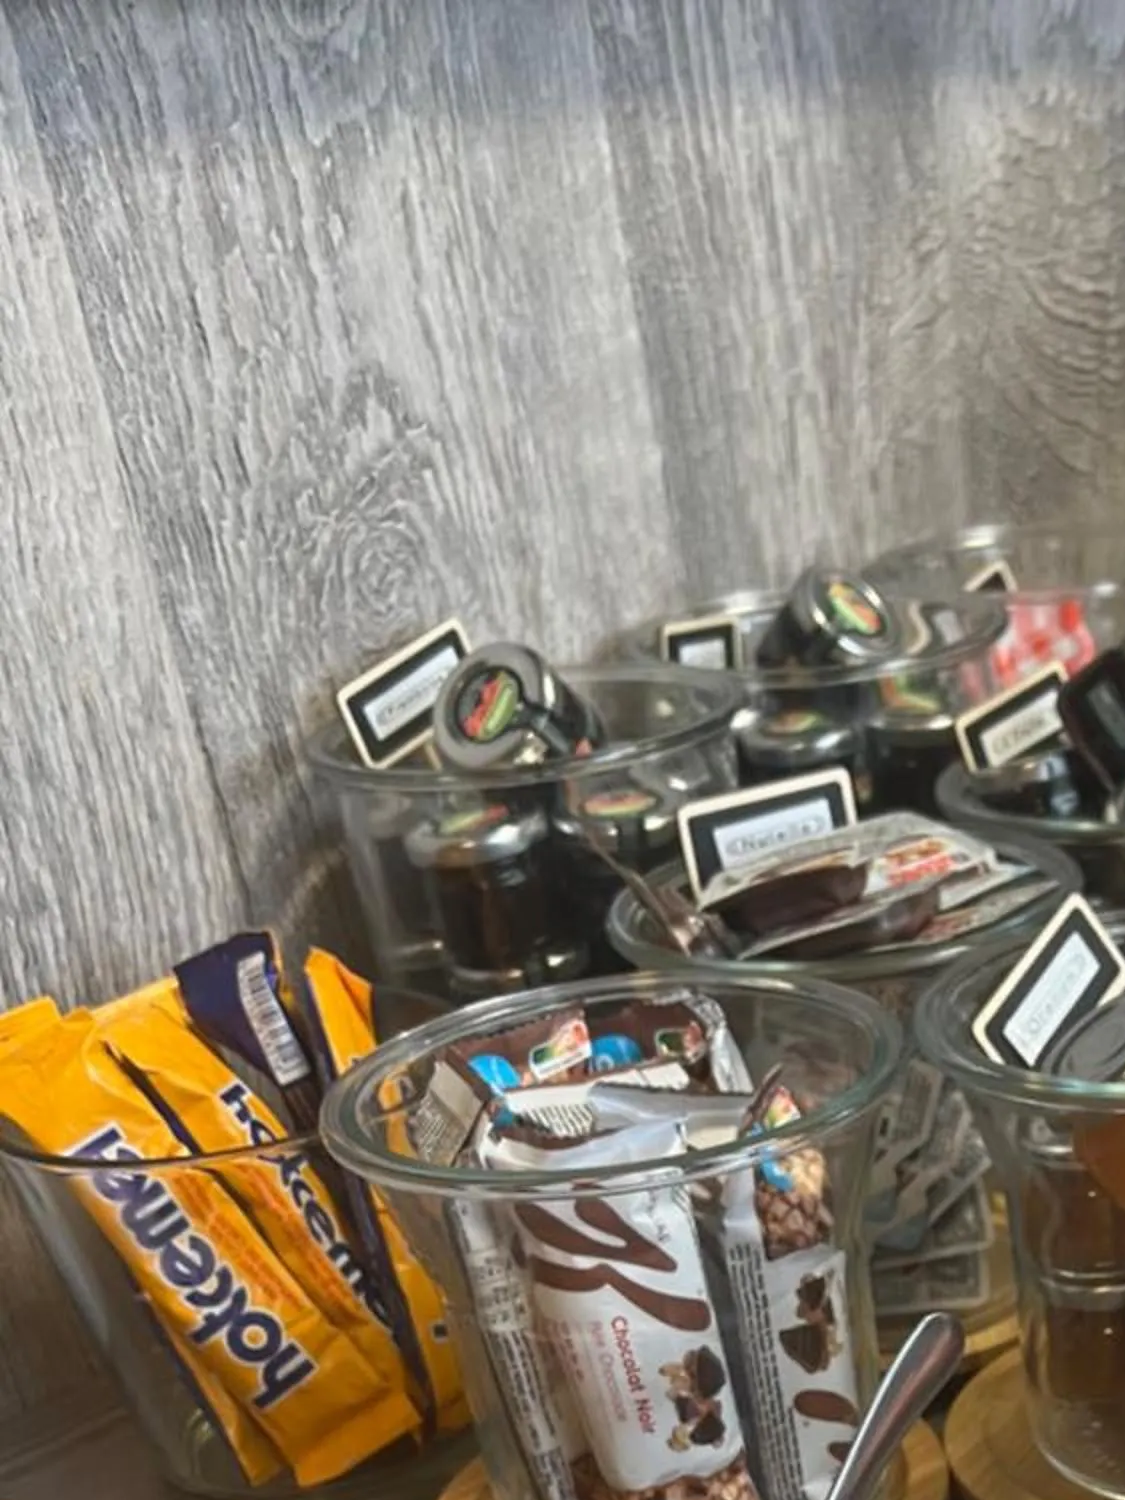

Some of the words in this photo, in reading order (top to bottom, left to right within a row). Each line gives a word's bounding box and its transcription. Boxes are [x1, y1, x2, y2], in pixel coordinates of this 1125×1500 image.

[69, 1126, 318, 1409] hotcemel
[219, 1083, 394, 1330] hotceme
[611, 1315, 647, 1392] Chocolat
[635, 1399, 656, 1434] Noir
